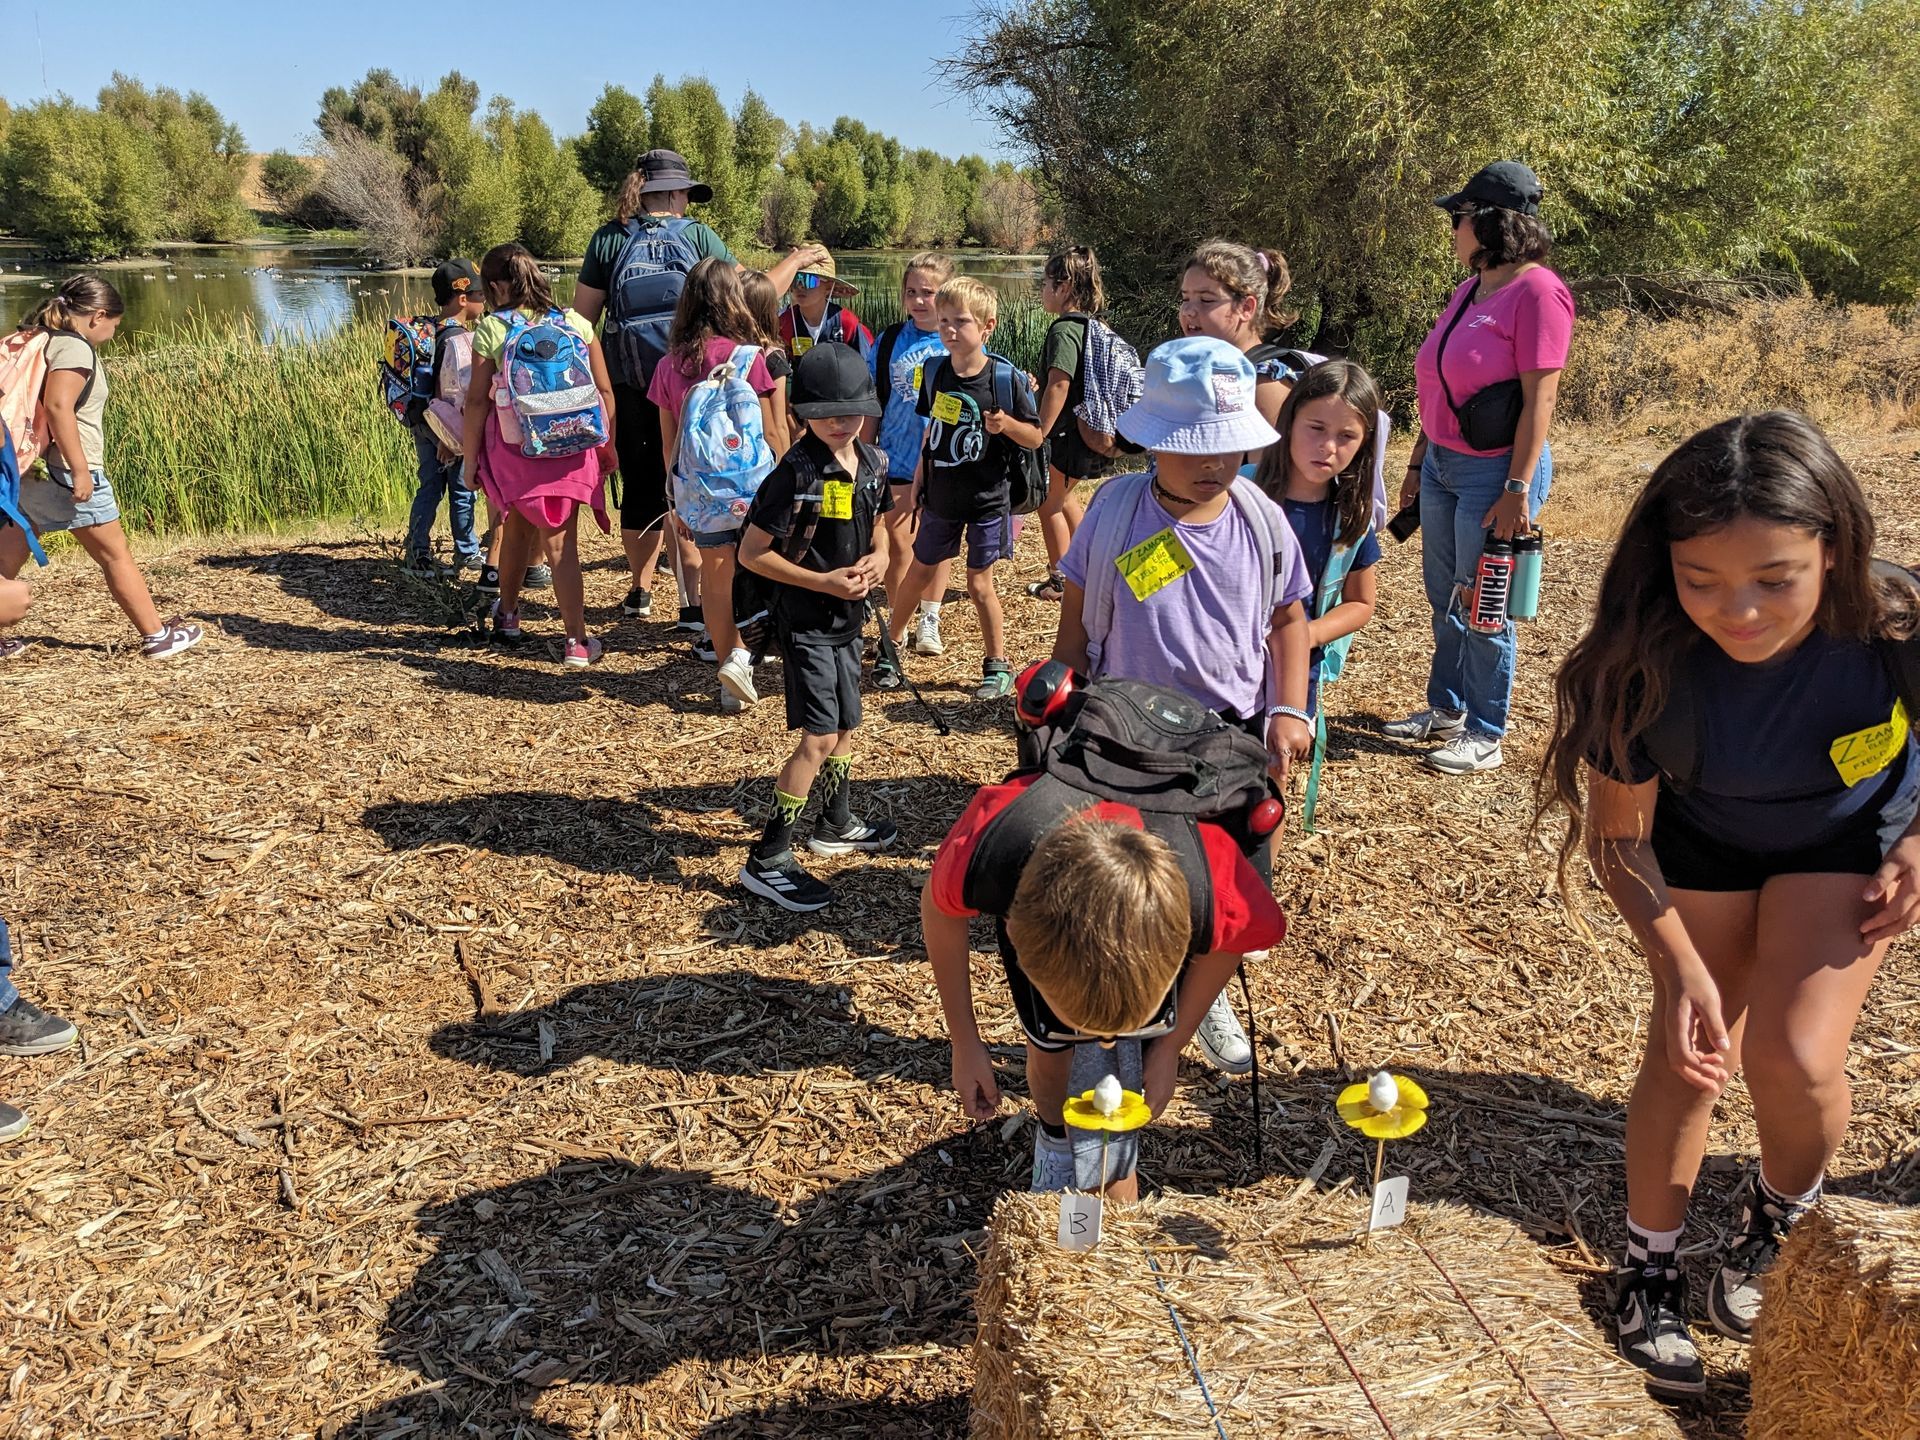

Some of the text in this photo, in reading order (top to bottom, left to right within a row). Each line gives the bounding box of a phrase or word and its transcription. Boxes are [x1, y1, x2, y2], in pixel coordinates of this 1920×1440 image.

[1136, 532, 1173, 558] ZAMORA
[1117, 551, 1138, 577] Z
[1475, 561, 1511, 624] PRIME
[1832, 736, 1857, 764] Z
[1379, 1191, 1395, 1216] A
[1069, 1212, 1089, 1235] B
